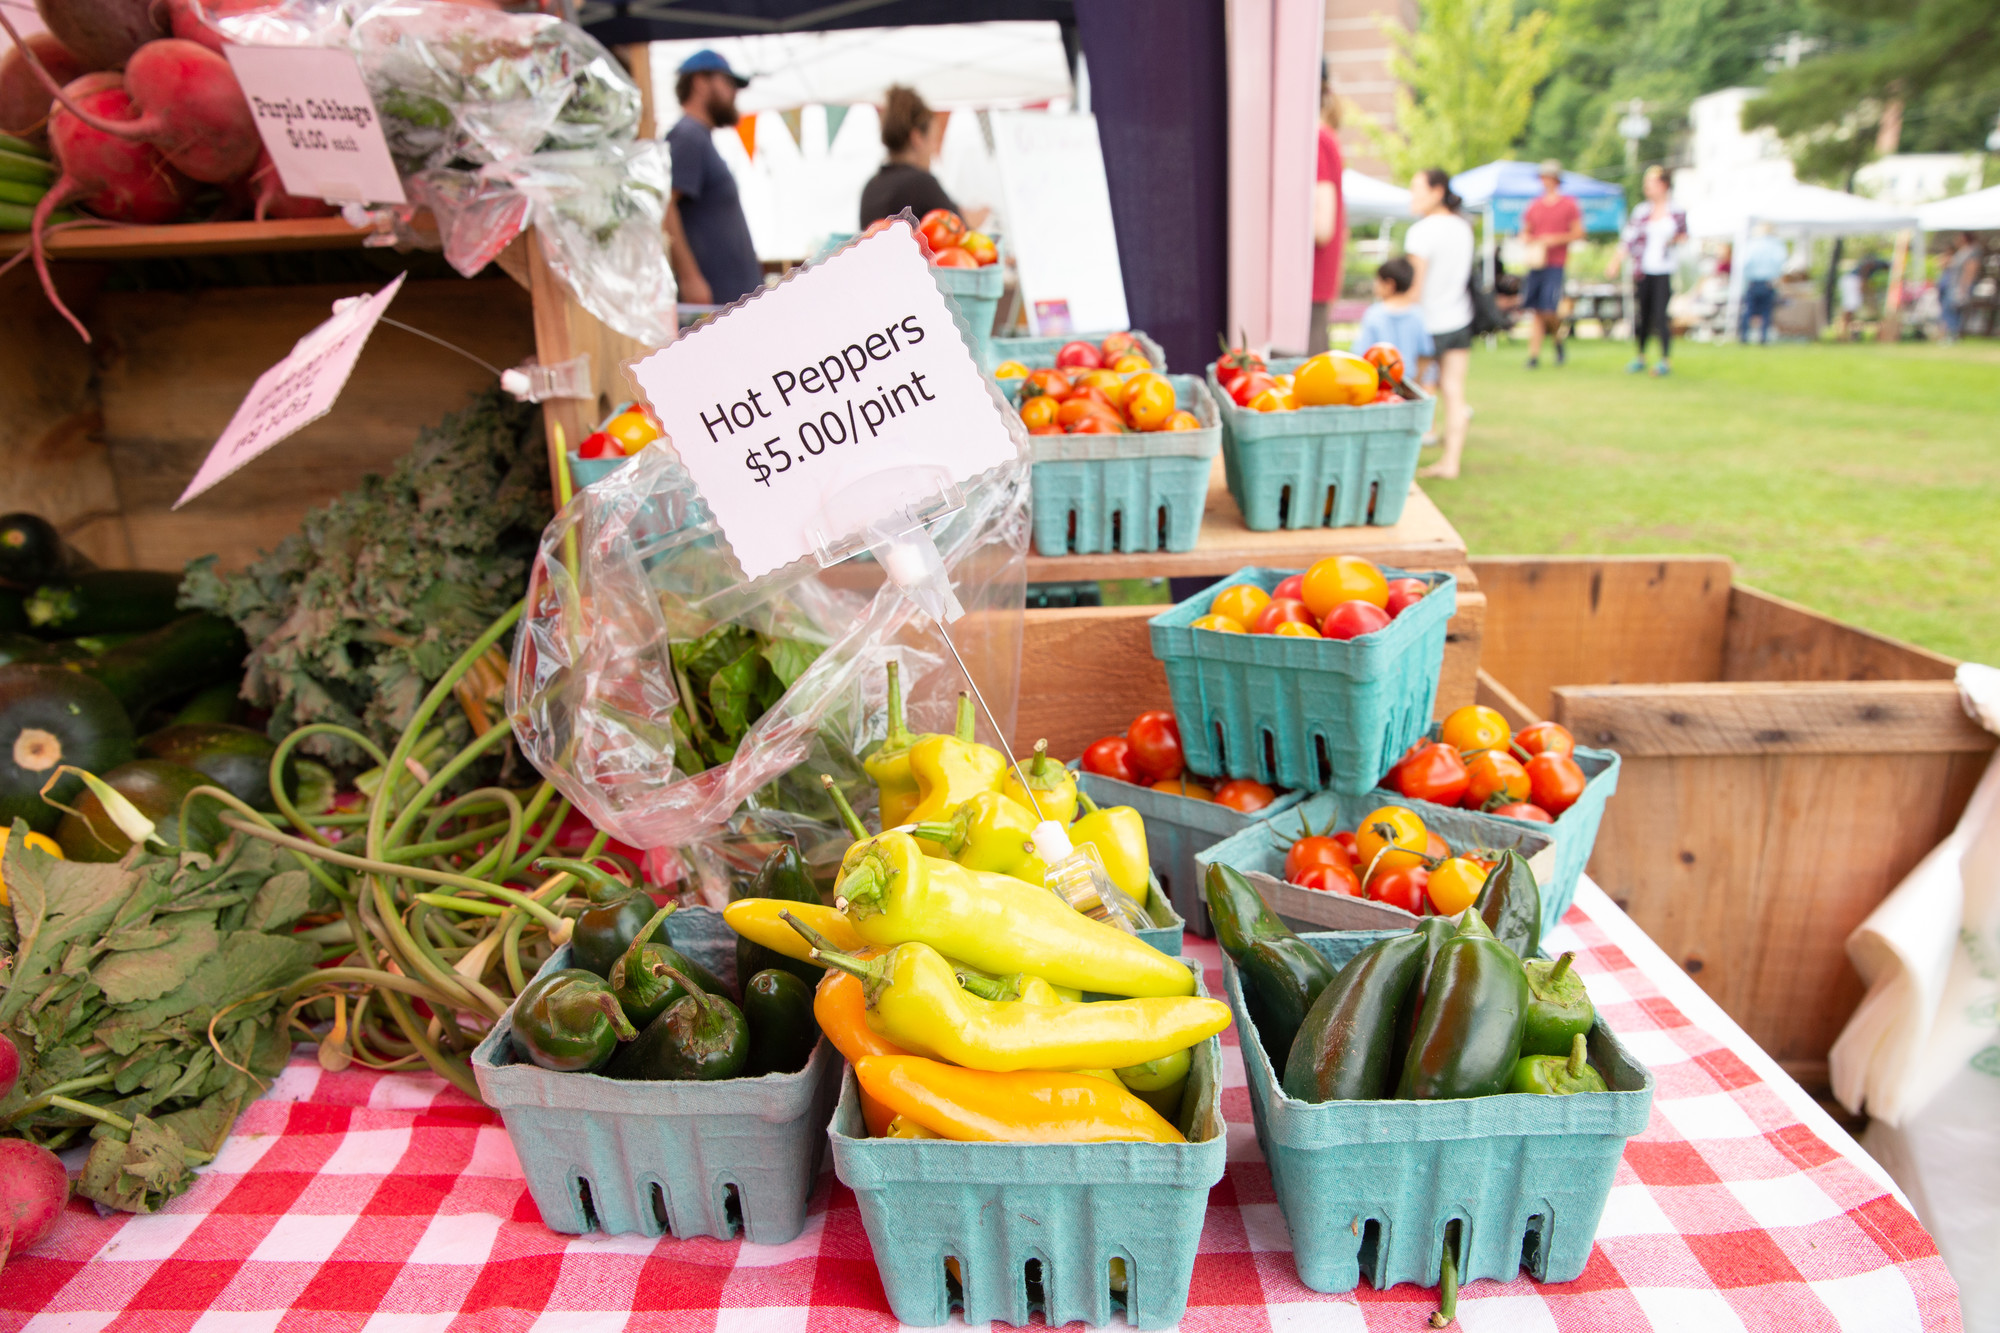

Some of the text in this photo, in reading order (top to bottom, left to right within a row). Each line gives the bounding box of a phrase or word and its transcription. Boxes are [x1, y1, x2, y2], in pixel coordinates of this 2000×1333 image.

[252, 96, 372, 128] Purple Cabbage
[332, 135, 360, 152] each
[699, 315, 925, 443] Hot Peppers
[745, 370, 936, 487] $5.00/pint
